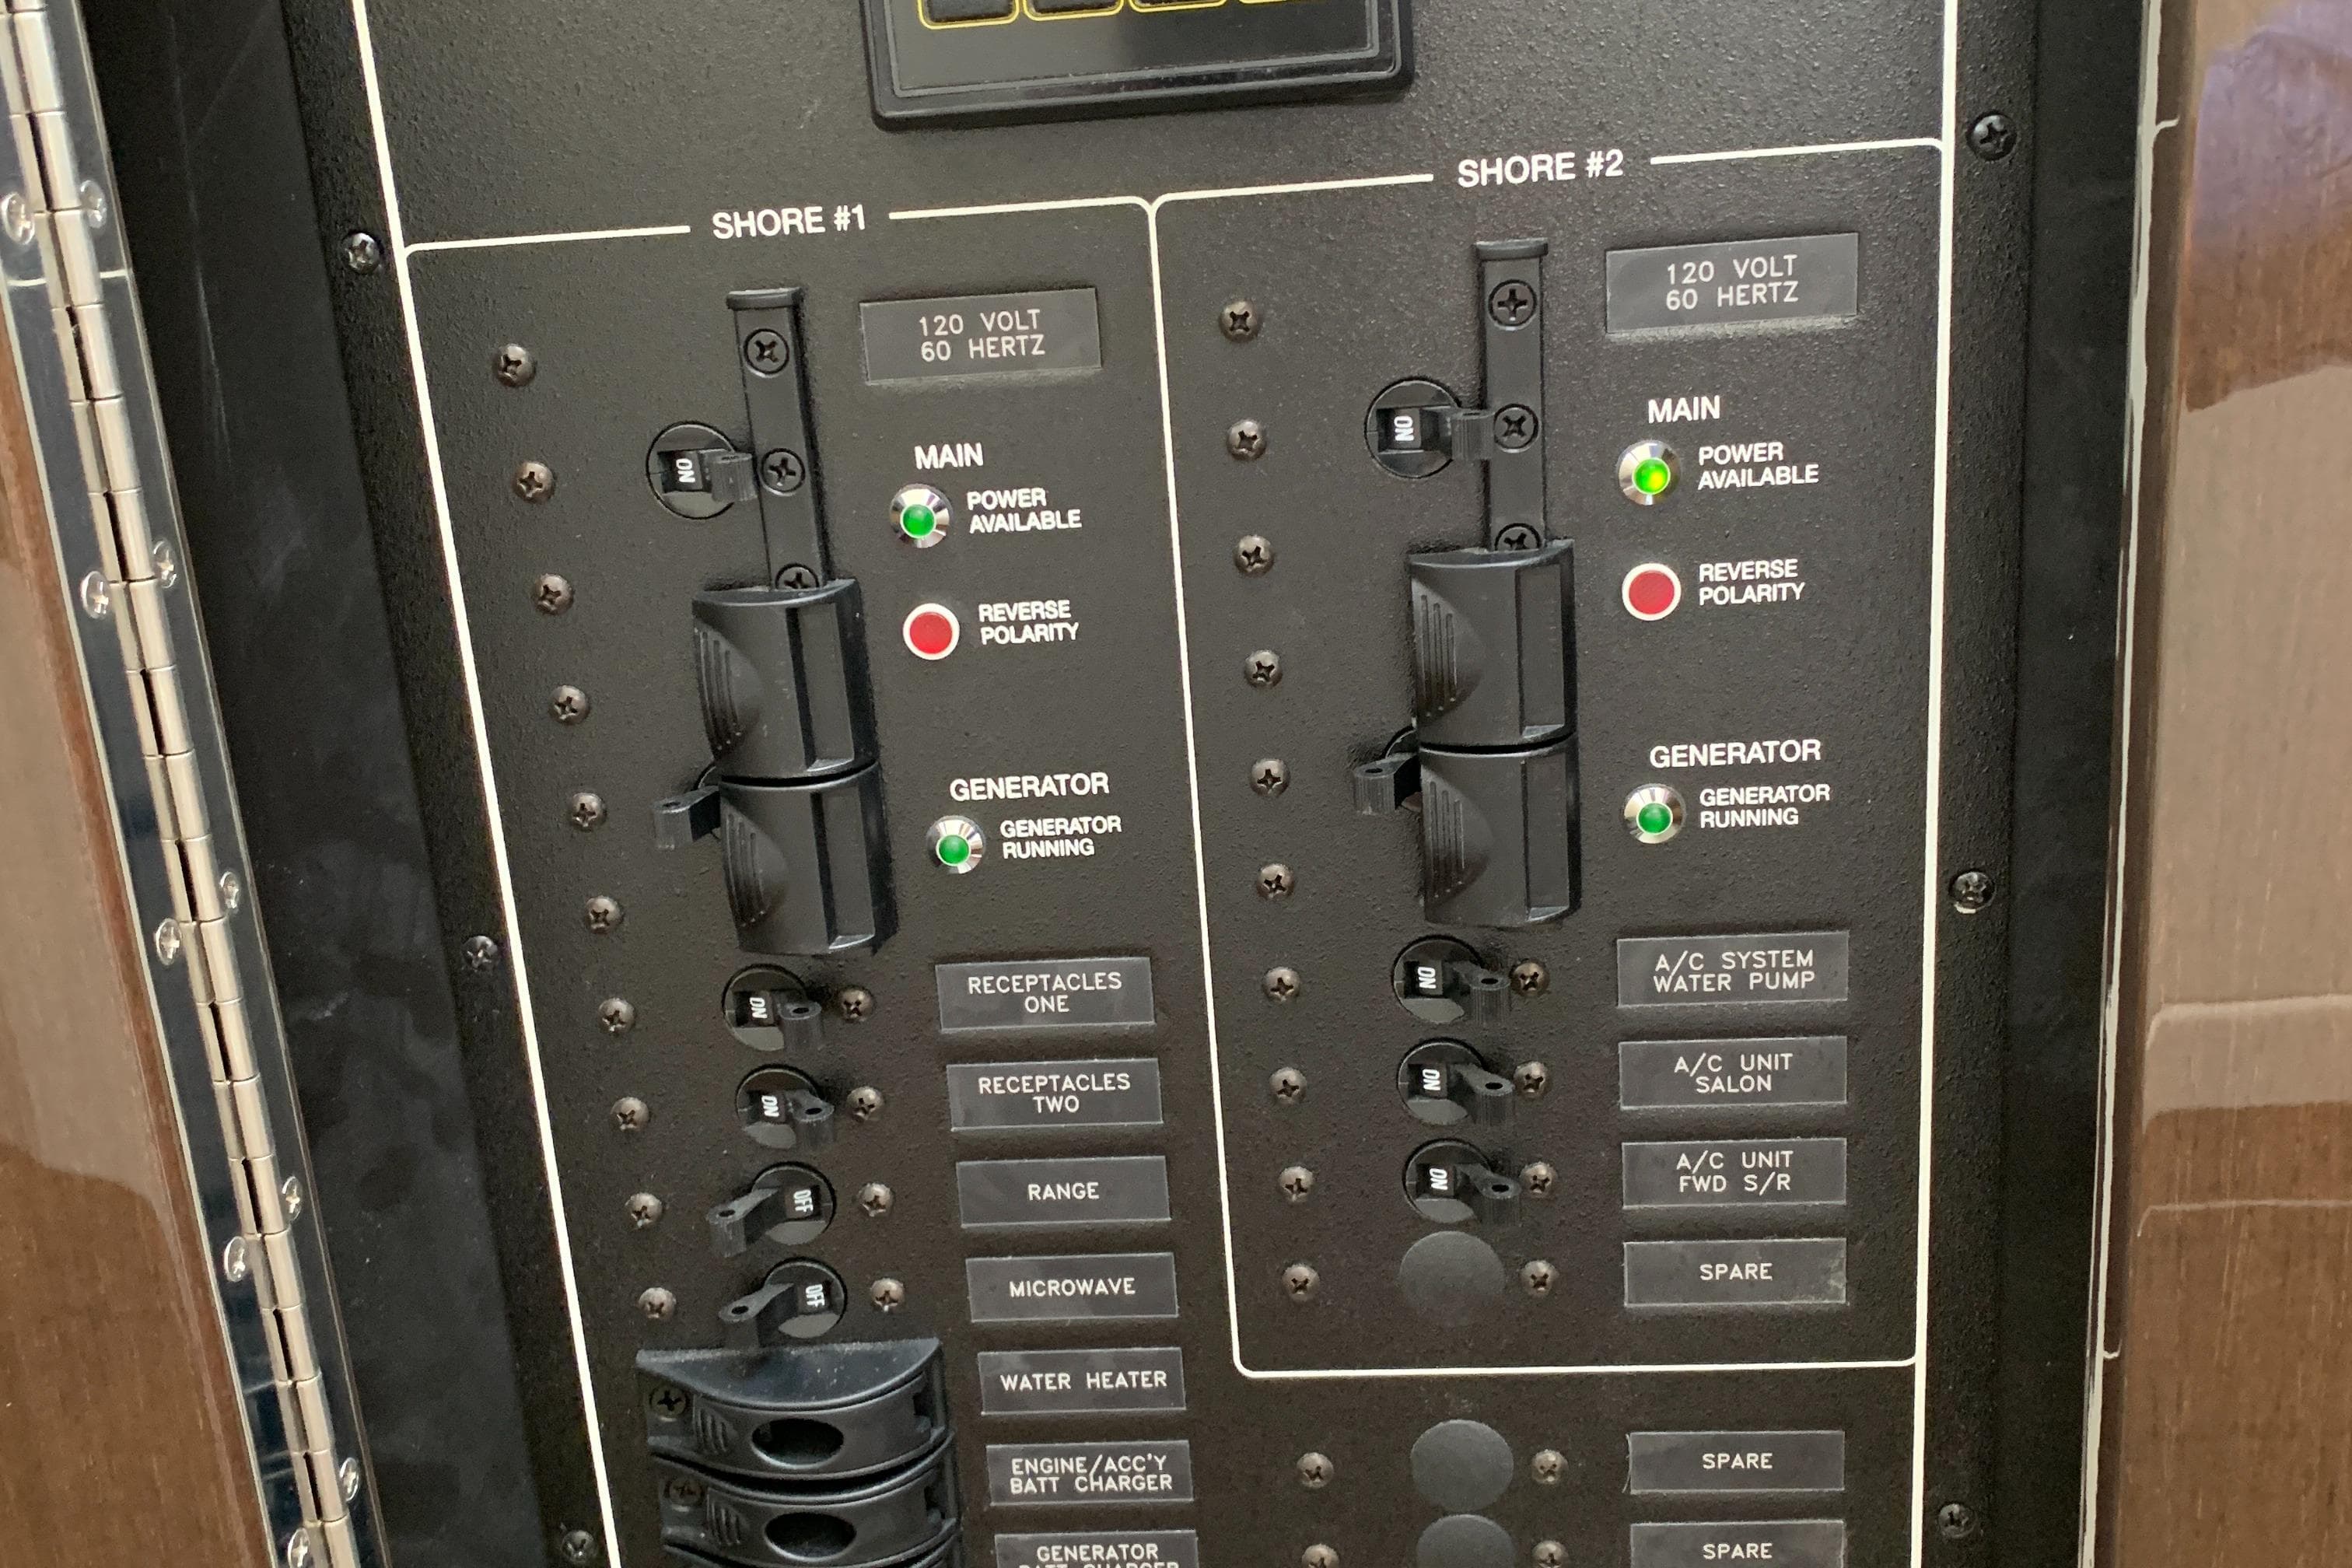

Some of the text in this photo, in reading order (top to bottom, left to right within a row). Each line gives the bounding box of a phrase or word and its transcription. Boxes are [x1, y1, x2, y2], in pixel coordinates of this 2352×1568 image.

[1458, 149, 1623, 187] SHORE #2
[712, 205, 865, 239] SHORE #1
[1668, 254, 1797, 284] 120 VOLT
[1667, 281, 1798, 310] 60 HERTZ
[919, 309, 1040, 336] 120 VOLT
[922, 334, 1045, 362] 60 HERTZ
[1648, 395, 1720, 423] MAIN
[1394, 416, 1414, 441] ON
[915, 443, 983, 469] MAIN
[1699, 442, 1783, 465] POWER
[677, 459, 695, 482] ON
[1698, 464, 1818, 490] AVAILABLE
[967, 488, 1046, 510] POWER
[970, 509, 1082, 534] AVAILABLE
[1699, 558, 1797, 582] REVERSE
[1699, 582, 1805, 605] POLARITY
[978, 600, 1071, 622] REVERSE
[981, 622, 1079, 645] POLARITY
[1650, 739, 1821, 768] GENERATOR
[950, 772, 1109, 801] GENERATOR
[1699, 784, 1830, 807] GENERATOR
[1000, 815, 1122, 839] GENERATOR
[1701, 807, 1798, 828] RUNNING
[1003, 838, 1094, 859] RUNNING
[1654, 950, 1812, 982] A/C SYSTEM
[968, 972, 1122, 996] RECEPTACLES
[1418, 967, 1436, 989] ON
[1654, 971, 1815, 992] WATER PUMP
[750, 998, 767, 1018] ON
[1025, 995, 1069, 1013] ONE
[1675, 1053, 1793, 1080] A/C UNIT
[978, 1073, 1130, 1094] RECEPTACLES
[1423, 1069, 1440, 1090] ON
[1696, 1075, 1771, 1093] SALON
[761, 1096, 779, 1117] ON
[1033, 1095, 1079, 1113] TWO
[1677, 1150, 1793, 1178] A/C UNIT
[1430, 1168, 1447, 1190] ON
[1680, 1172, 1790, 1195] FWD S/R
[793, 1189, 813, 1212] OFF
[1028, 1182, 1099, 1200] RANGE
[1700, 1263, 1772, 1280] SPARE
[806, 1284, 824, 1307] OFF
[1010, 1278, 1135, 1297] MICROWAVE
[1000, 1370, 1167, 1391] WATER HEATER
[1012, 1454, 1167, 1475] ENGINE/ACC'Y
[1703, 1453, 1772, 1469] SPARE
[1010, 1475, 1172, 1494] BATT CHARGER
[1037, 1544, 1158, 1563] GENERATOR
[1703, 1543, 1772, 1559] SPARE
